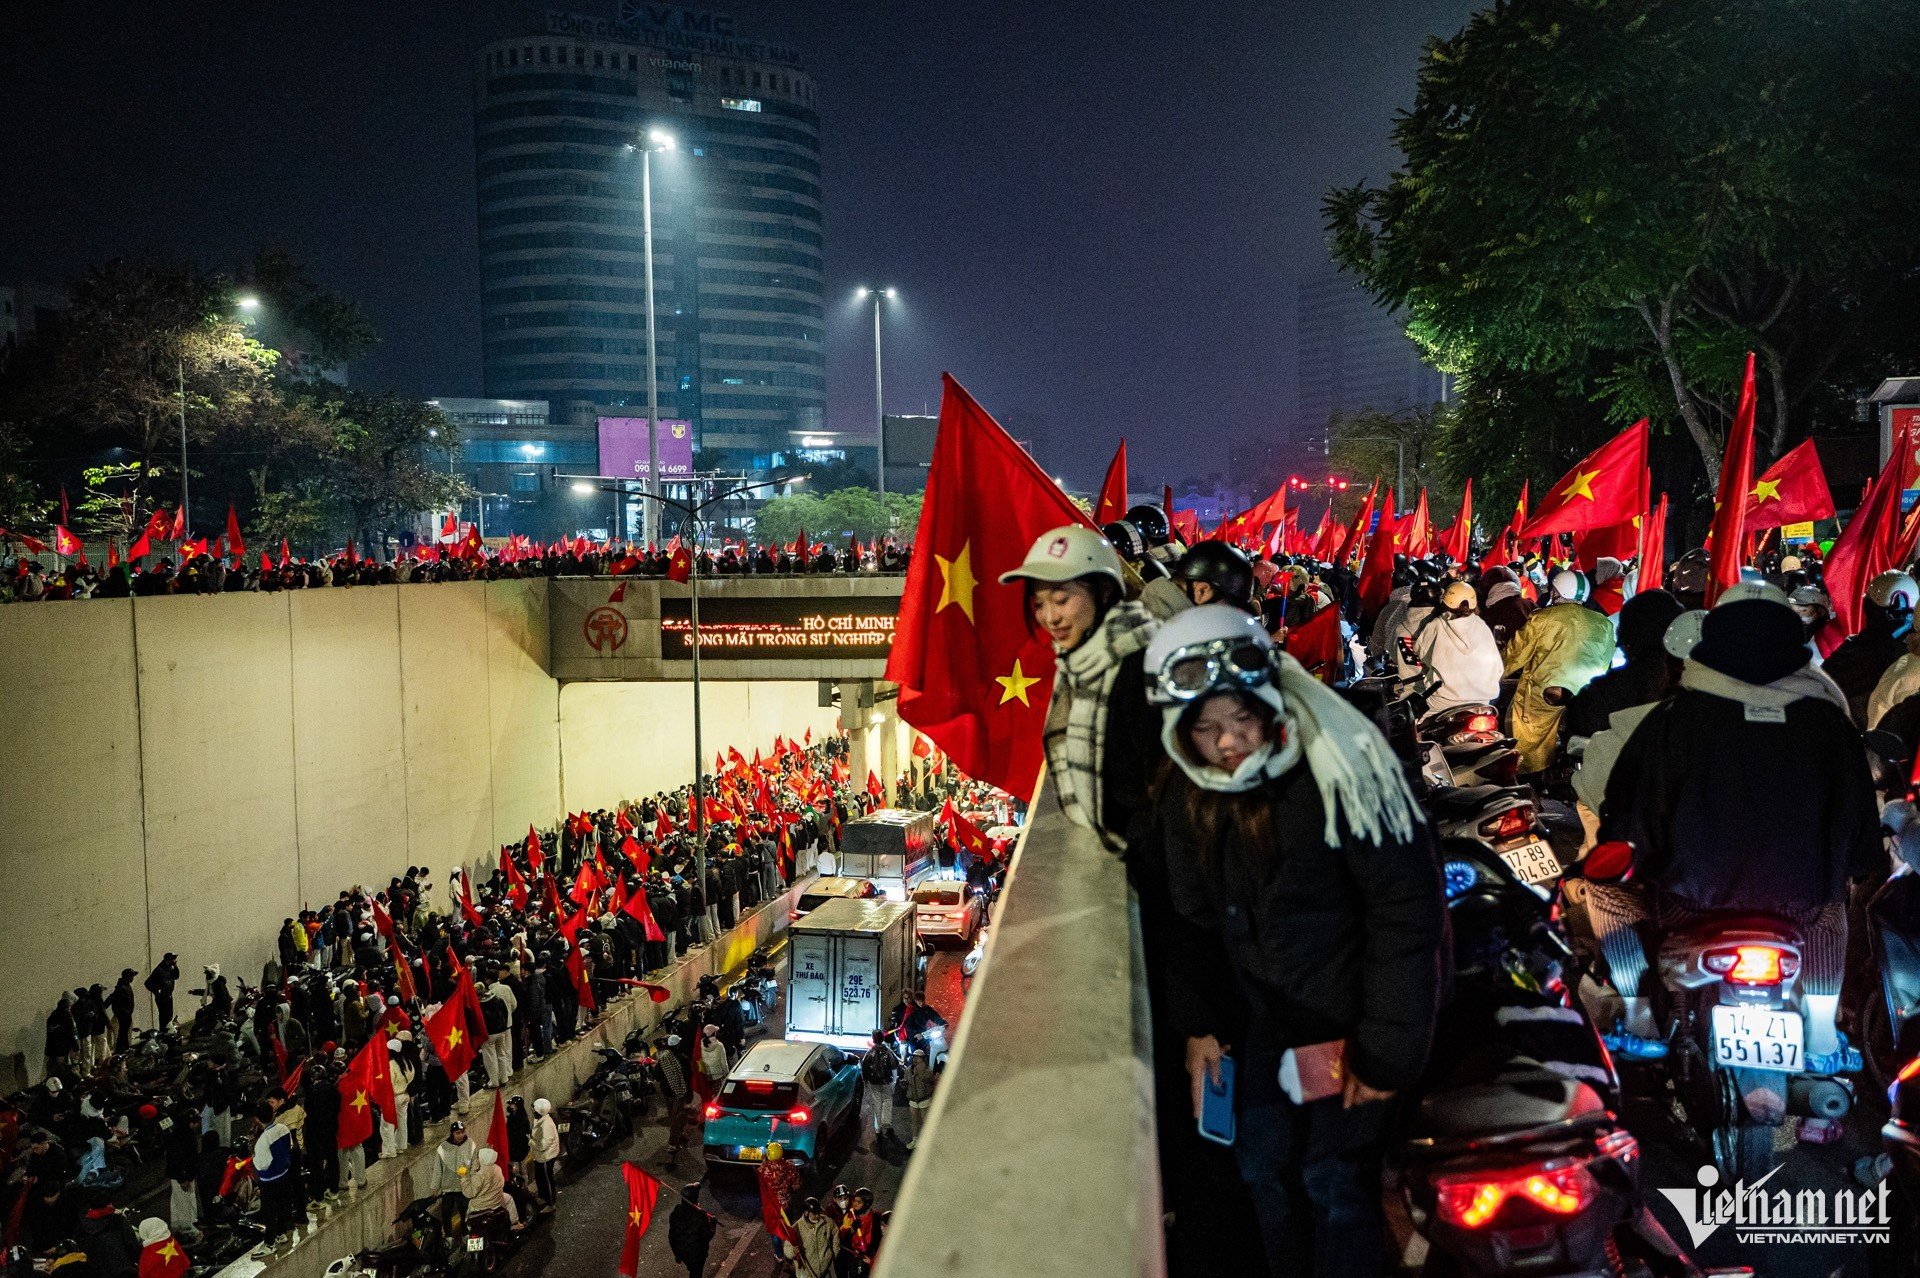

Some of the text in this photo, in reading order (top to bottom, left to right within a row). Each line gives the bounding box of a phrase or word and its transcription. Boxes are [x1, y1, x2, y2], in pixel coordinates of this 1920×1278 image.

[668, 465, 687, 473] 6699
[828, 614, 853, 630] CHÍ
[855, 617, 895, 630] MINH
[725, 632, 754, 645] MÃI
[756, 633, 807, 645] TRONG
[1507, 845, 1545, 868] 17-B9
[1518, 859, 1559, 882] 04.68
[849, 975, 863, 985] 29E
[844, 988, 871, 998] 523.76
[1720, 1037, 1798, 1066] 551.37
